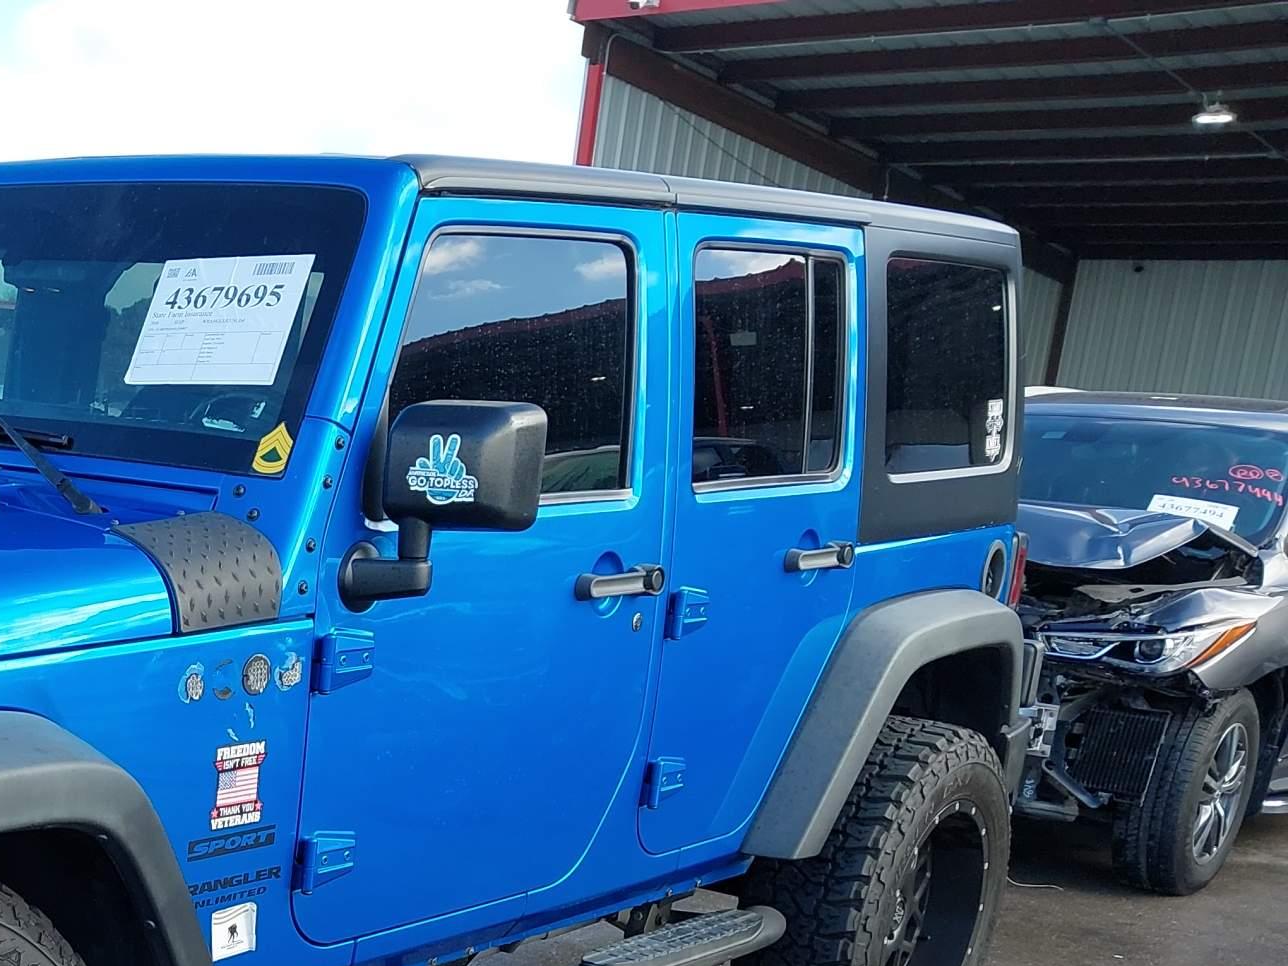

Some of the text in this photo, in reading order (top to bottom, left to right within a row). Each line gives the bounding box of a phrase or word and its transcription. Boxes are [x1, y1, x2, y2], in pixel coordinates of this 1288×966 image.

[165, 284, 285, 310] 43679695
[408, 475, 475, 489] GO TOPLESS
[217, 741, 266, 761] FREEDOM
[241, 756, 257, 767] FREE
[219, 802, 255, 817] THANK YOU
[210, 811, 261, 830] VETERANS
[192, 831, 269, 856] SPORT
[187, 866, 282, 897] RANGLER
[194, 886, 267, 910] NLIMITED
